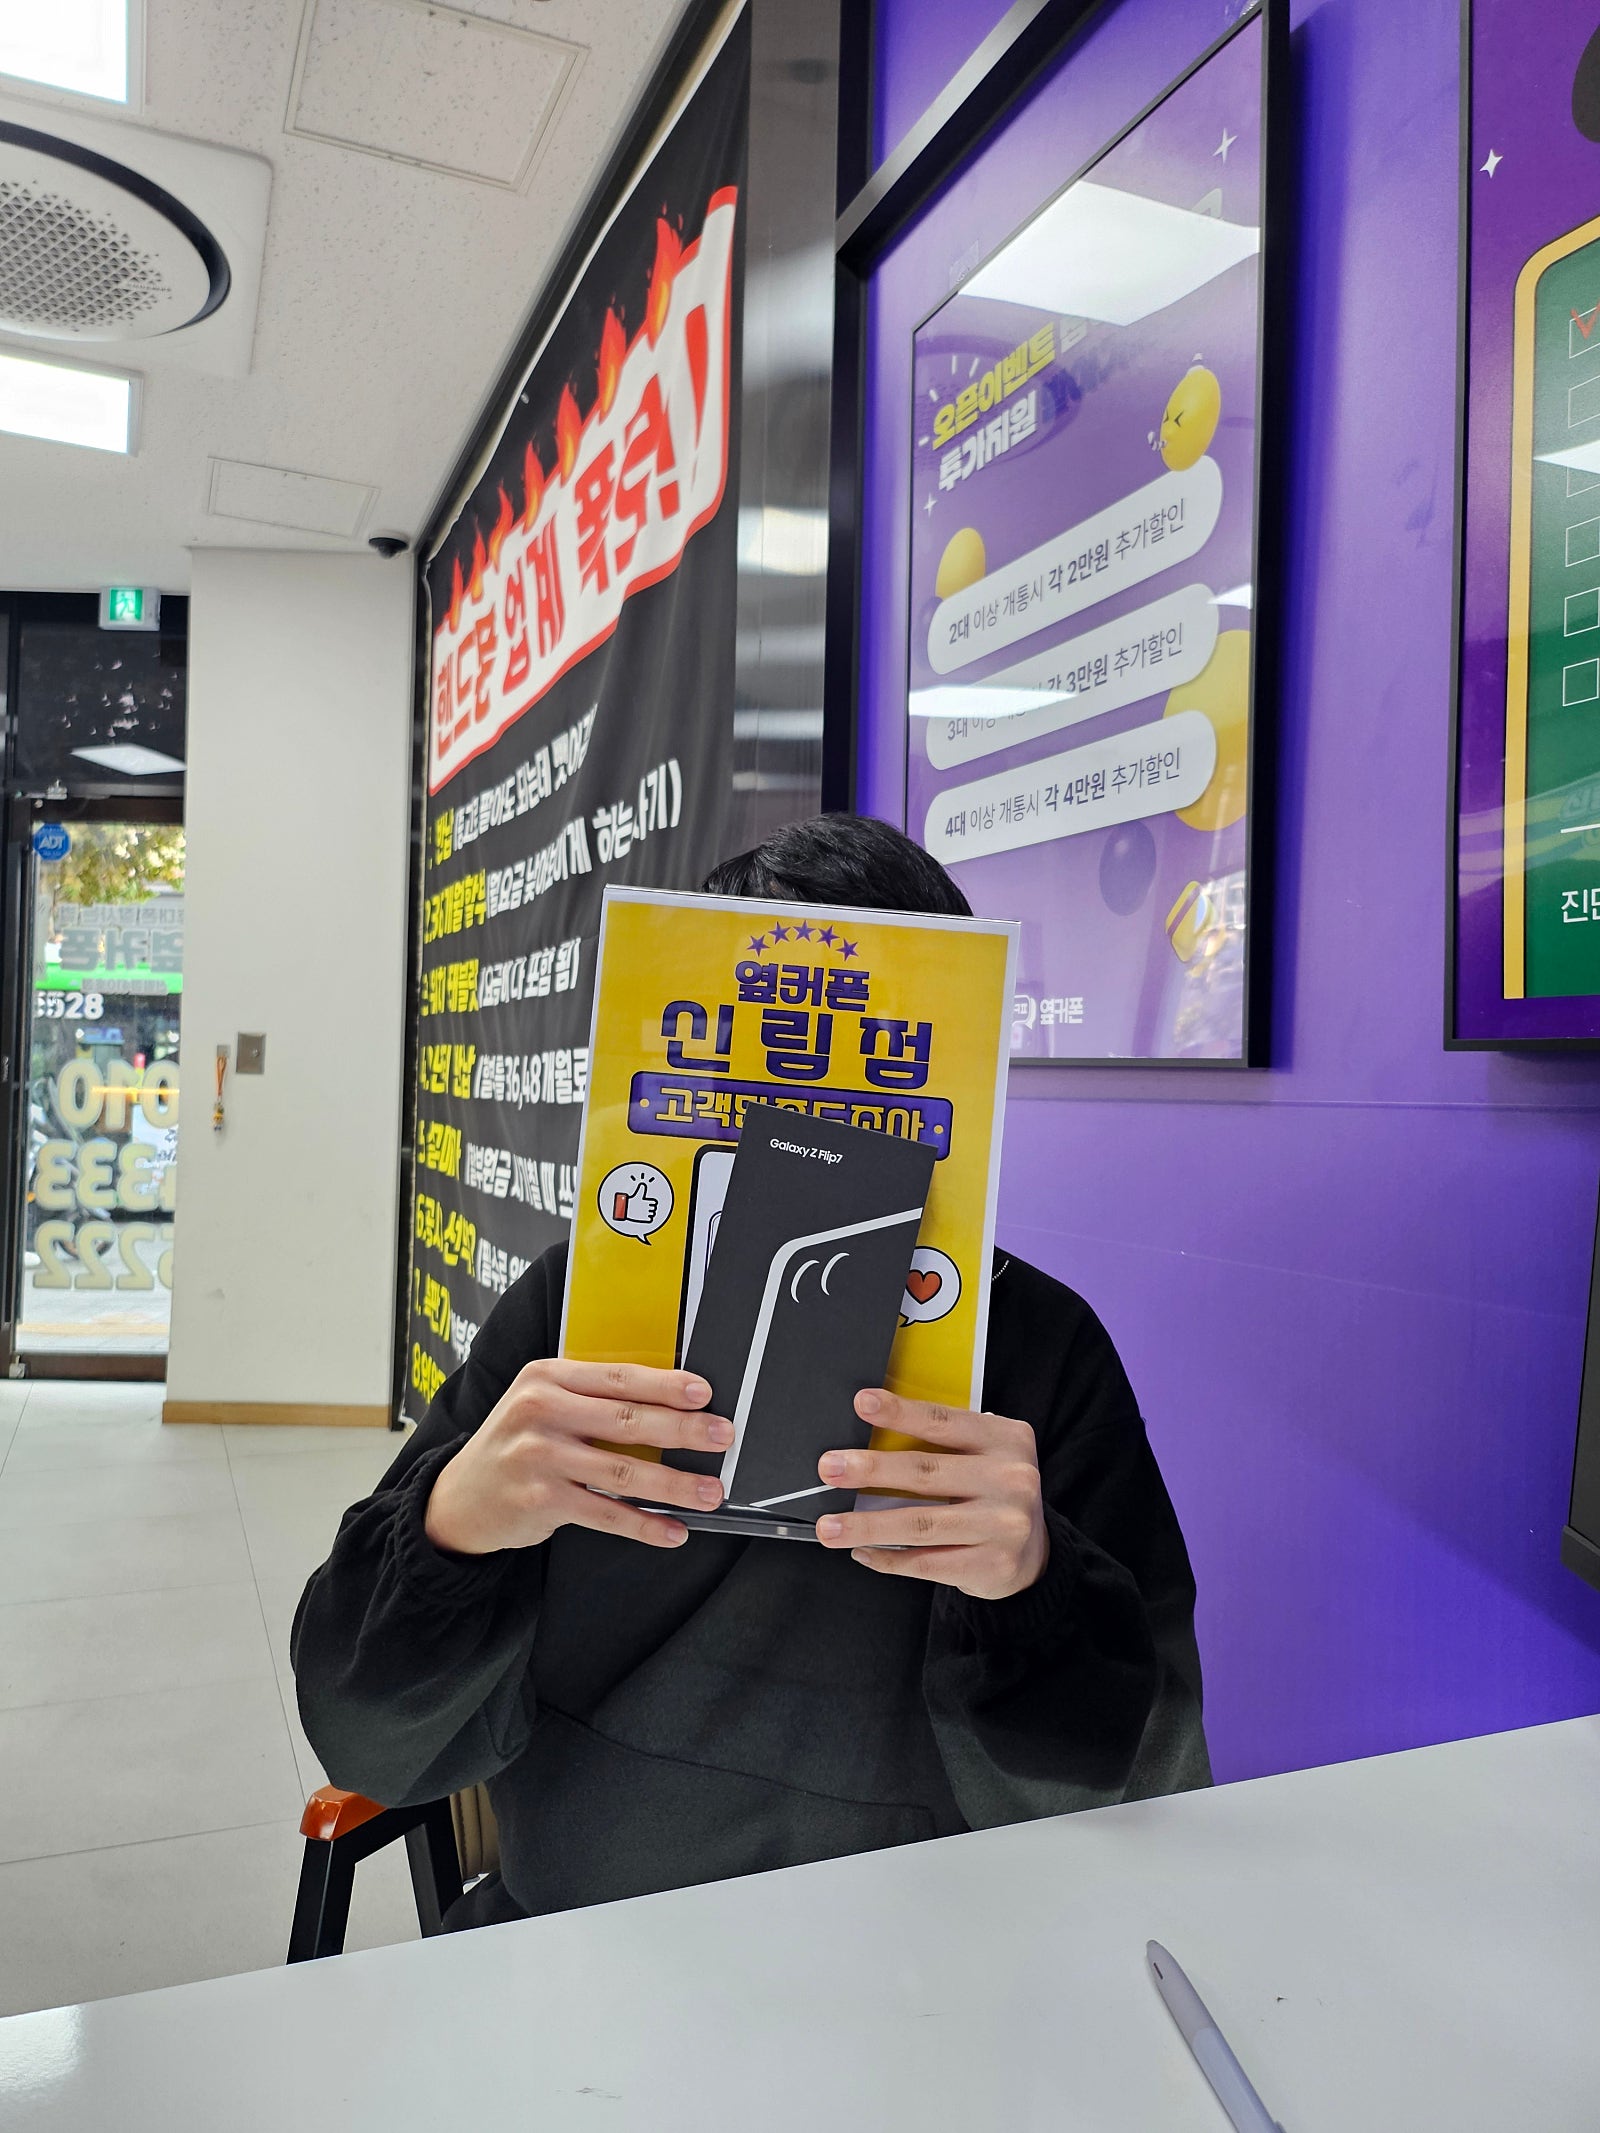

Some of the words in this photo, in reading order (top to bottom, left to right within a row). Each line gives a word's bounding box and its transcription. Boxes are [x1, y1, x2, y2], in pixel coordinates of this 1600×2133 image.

[933, 320, 1057, 452] 오픈이벤트
[949, 613, 970, 645] 2대
[973, 599, 999, 632] 이상
[1002, 574, 1043, 617] 개통시
[1048, 562, 1064, 594] 각
[1067, 539, 1109, 586] 2만원
[1113, 498, 1185, 561] 추가할인
[436, 611, 498, 760] 핸드폰
[503, 507, 566, 698] 업계
[1066, 653, 1109, 694] 3만원
[1112, 621, 1183, 678] 추가할인
[945, 810, 967, 838] 4대
[970, 803, 996, 832] 이상
[999, 788, 1040, 824] 개통시
[1044, 784, 1060, 812] 각
[1063, 768, 1106, 806] 4만원
[1110, 746, 1181, 795] 추가할인
[37, 834, 66, 850] ADT
[734, 960, 871, 1013] 옆커폰
[1039, 997, 1084, 1026] 옆커폰
[769, 1138, 811, 1158] Galaxy
[809, 1147, 818, 1158] Z
[817, 1149, 844, 1165] Flip7
